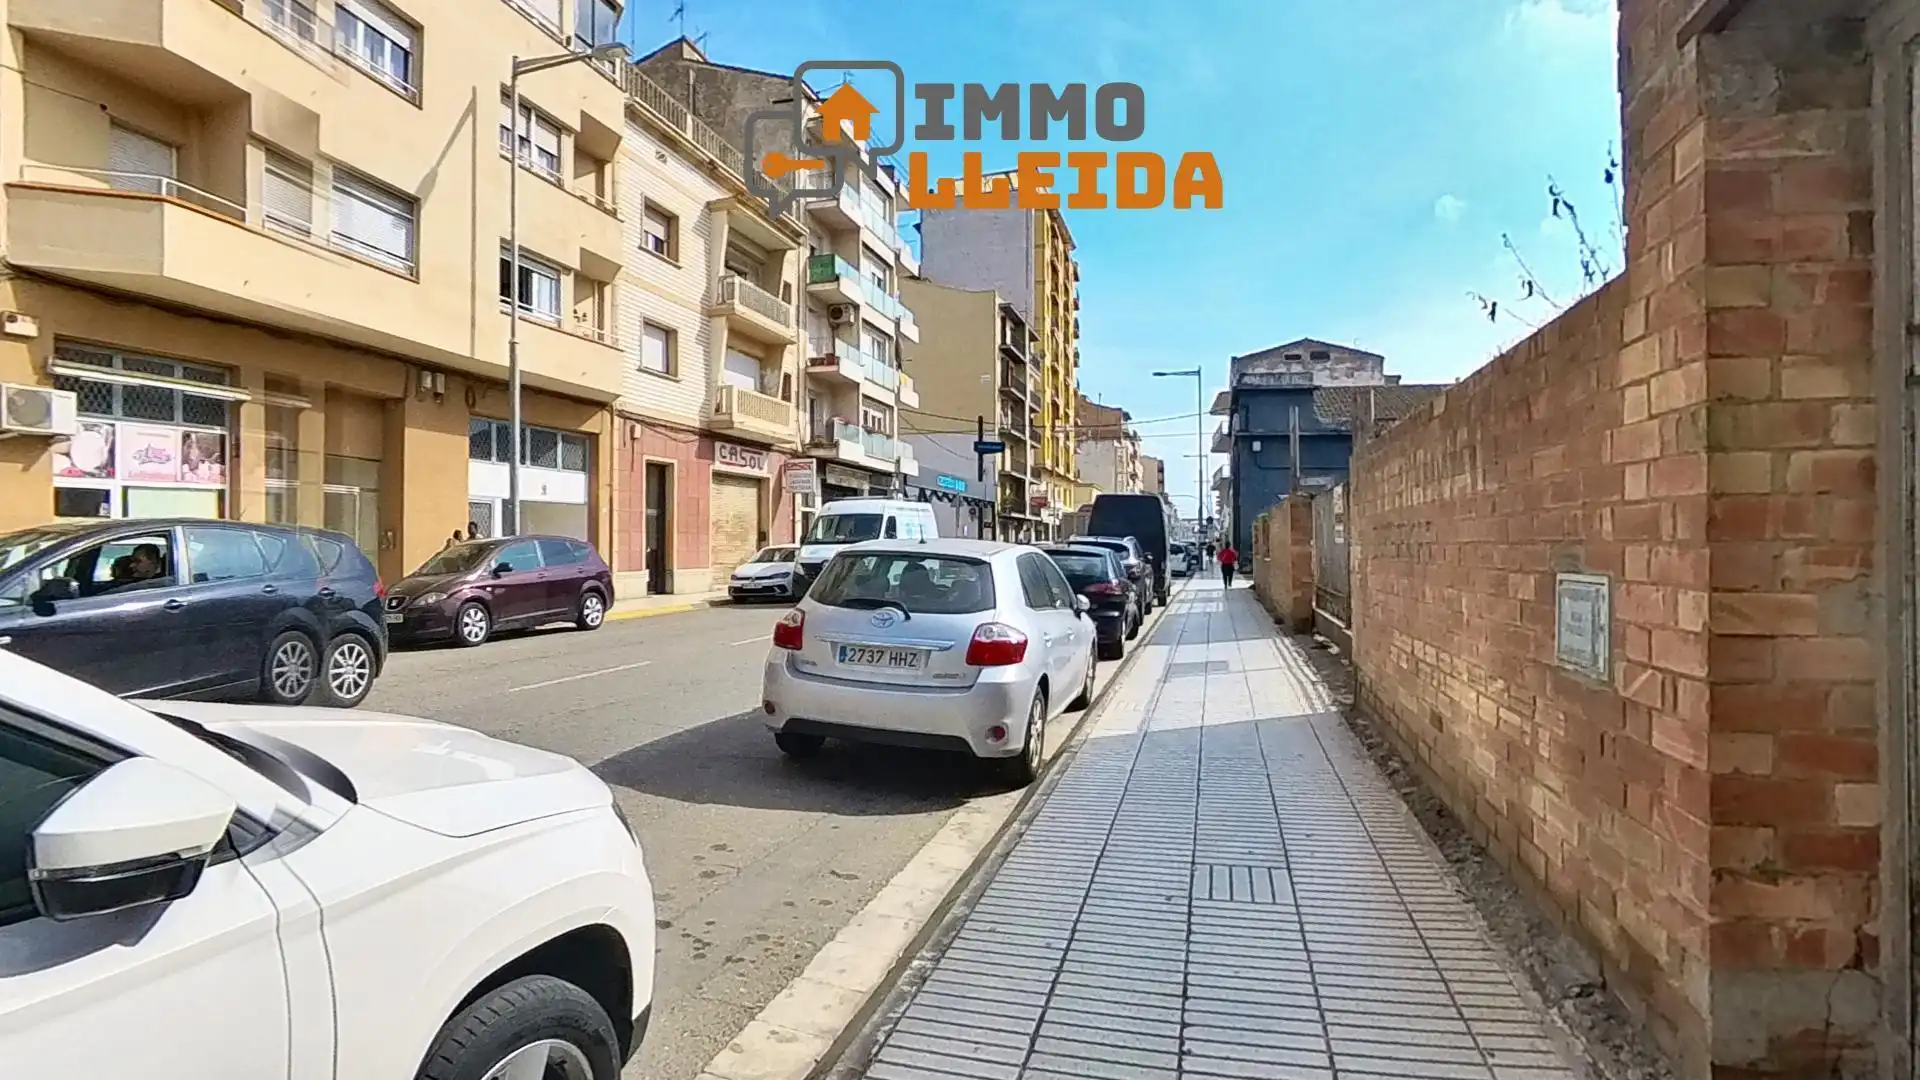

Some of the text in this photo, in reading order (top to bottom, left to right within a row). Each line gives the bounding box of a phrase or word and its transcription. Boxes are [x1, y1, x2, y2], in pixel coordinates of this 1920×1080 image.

[719, 443, 764, 471] CASOL
[847, 648, 918, 667] 2737 HHZ
